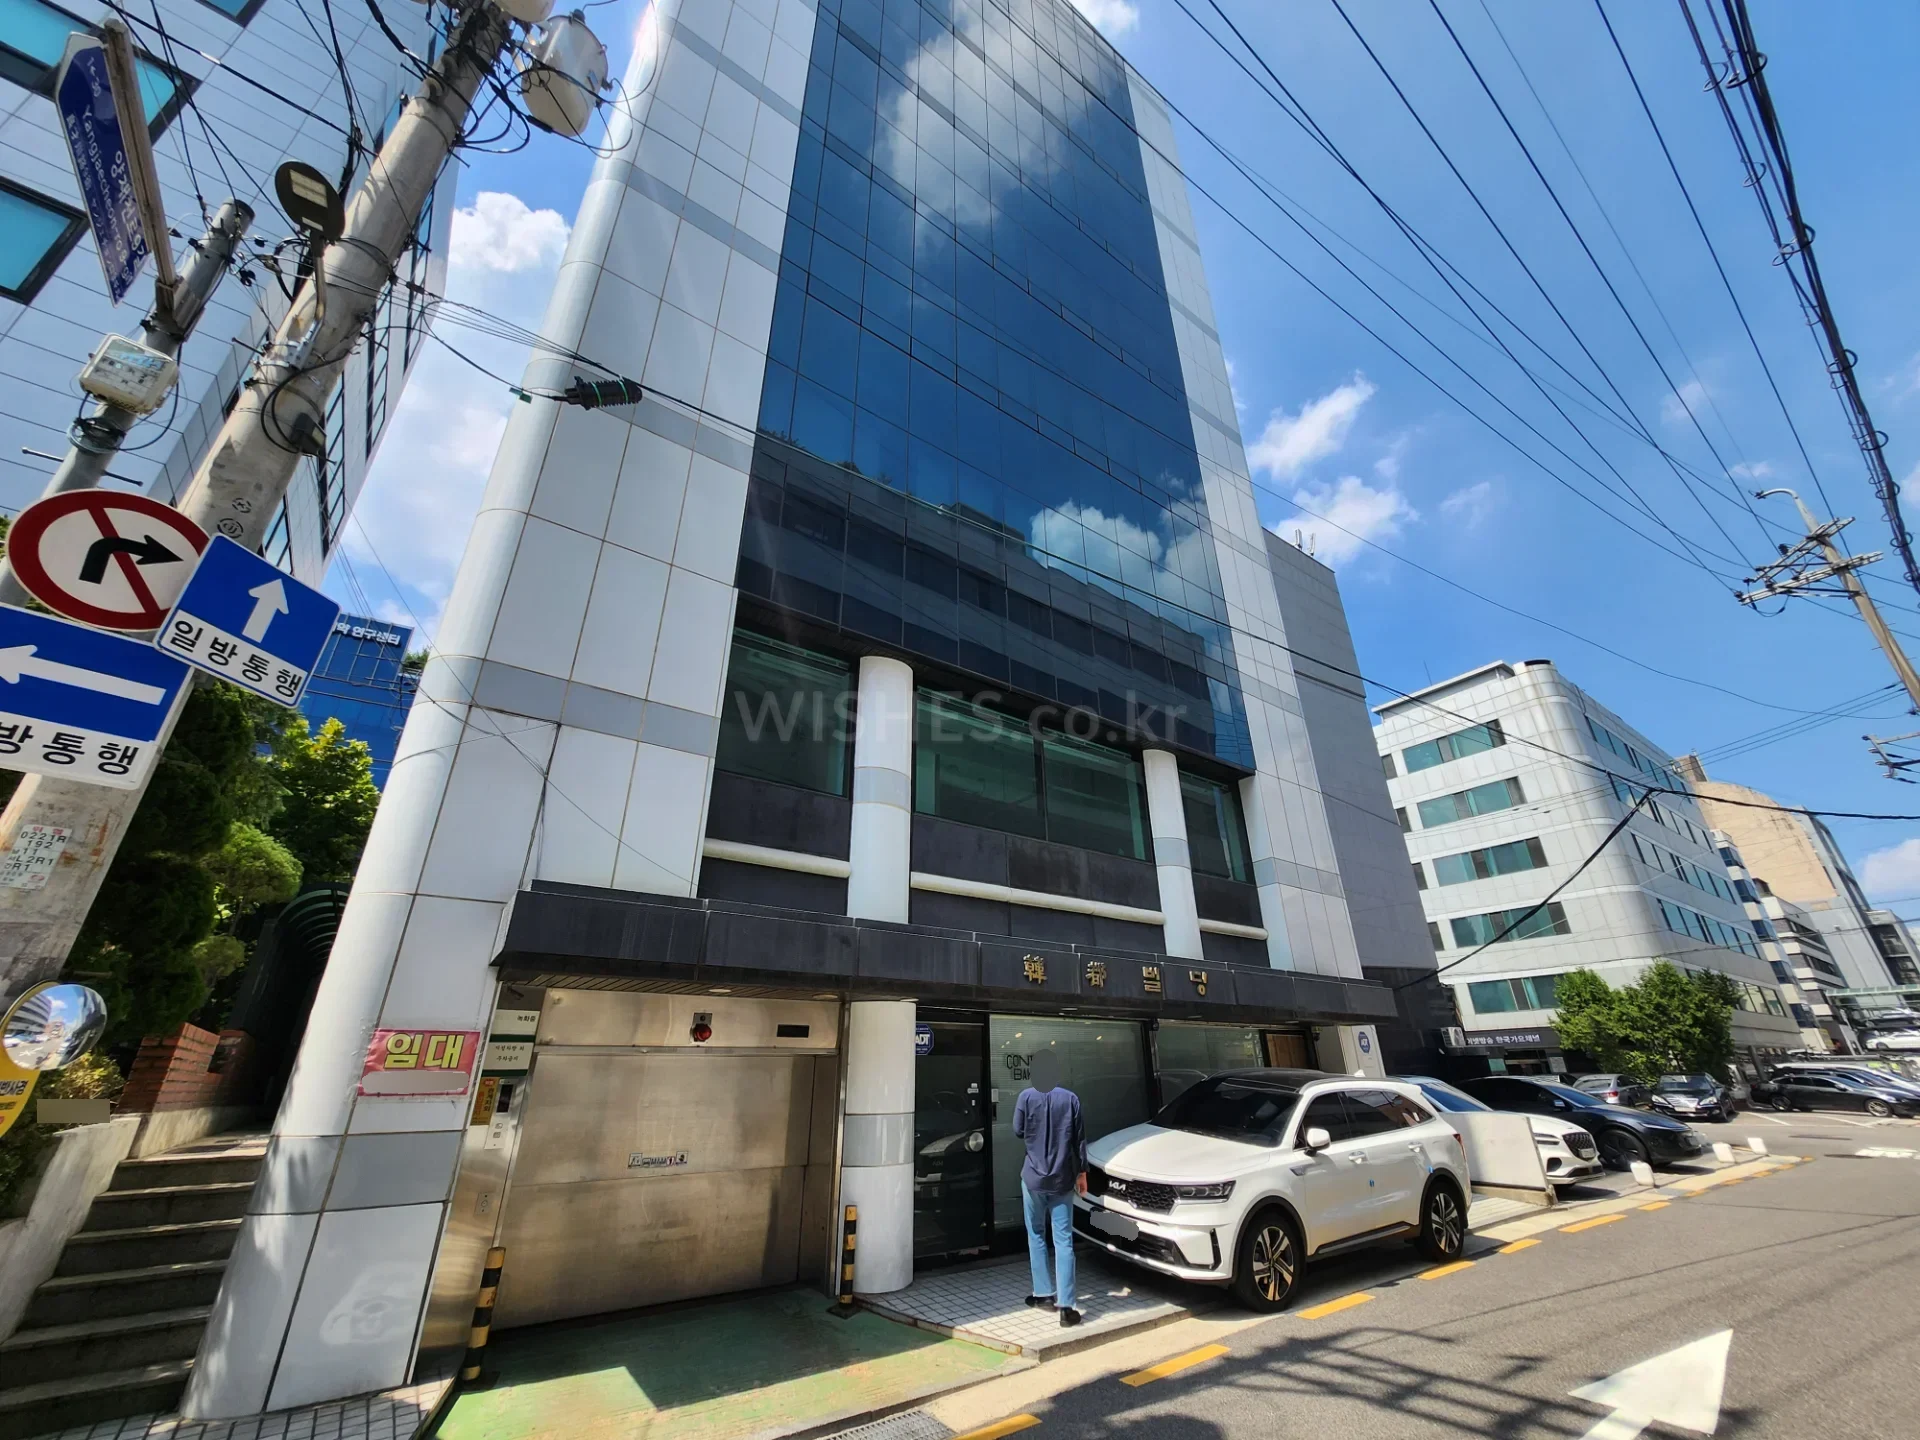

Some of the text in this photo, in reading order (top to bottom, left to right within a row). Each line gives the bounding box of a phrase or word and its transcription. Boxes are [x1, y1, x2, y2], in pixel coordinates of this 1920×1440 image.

[352, 626, 401, 646] 연구센터
[170, 620, 302, 698] 일방통행
[915, 1033, 930, 1045] ADT
[384, 1032, 465, 1069] 임대
[1108, 1180, 1126, 1191] KIA
